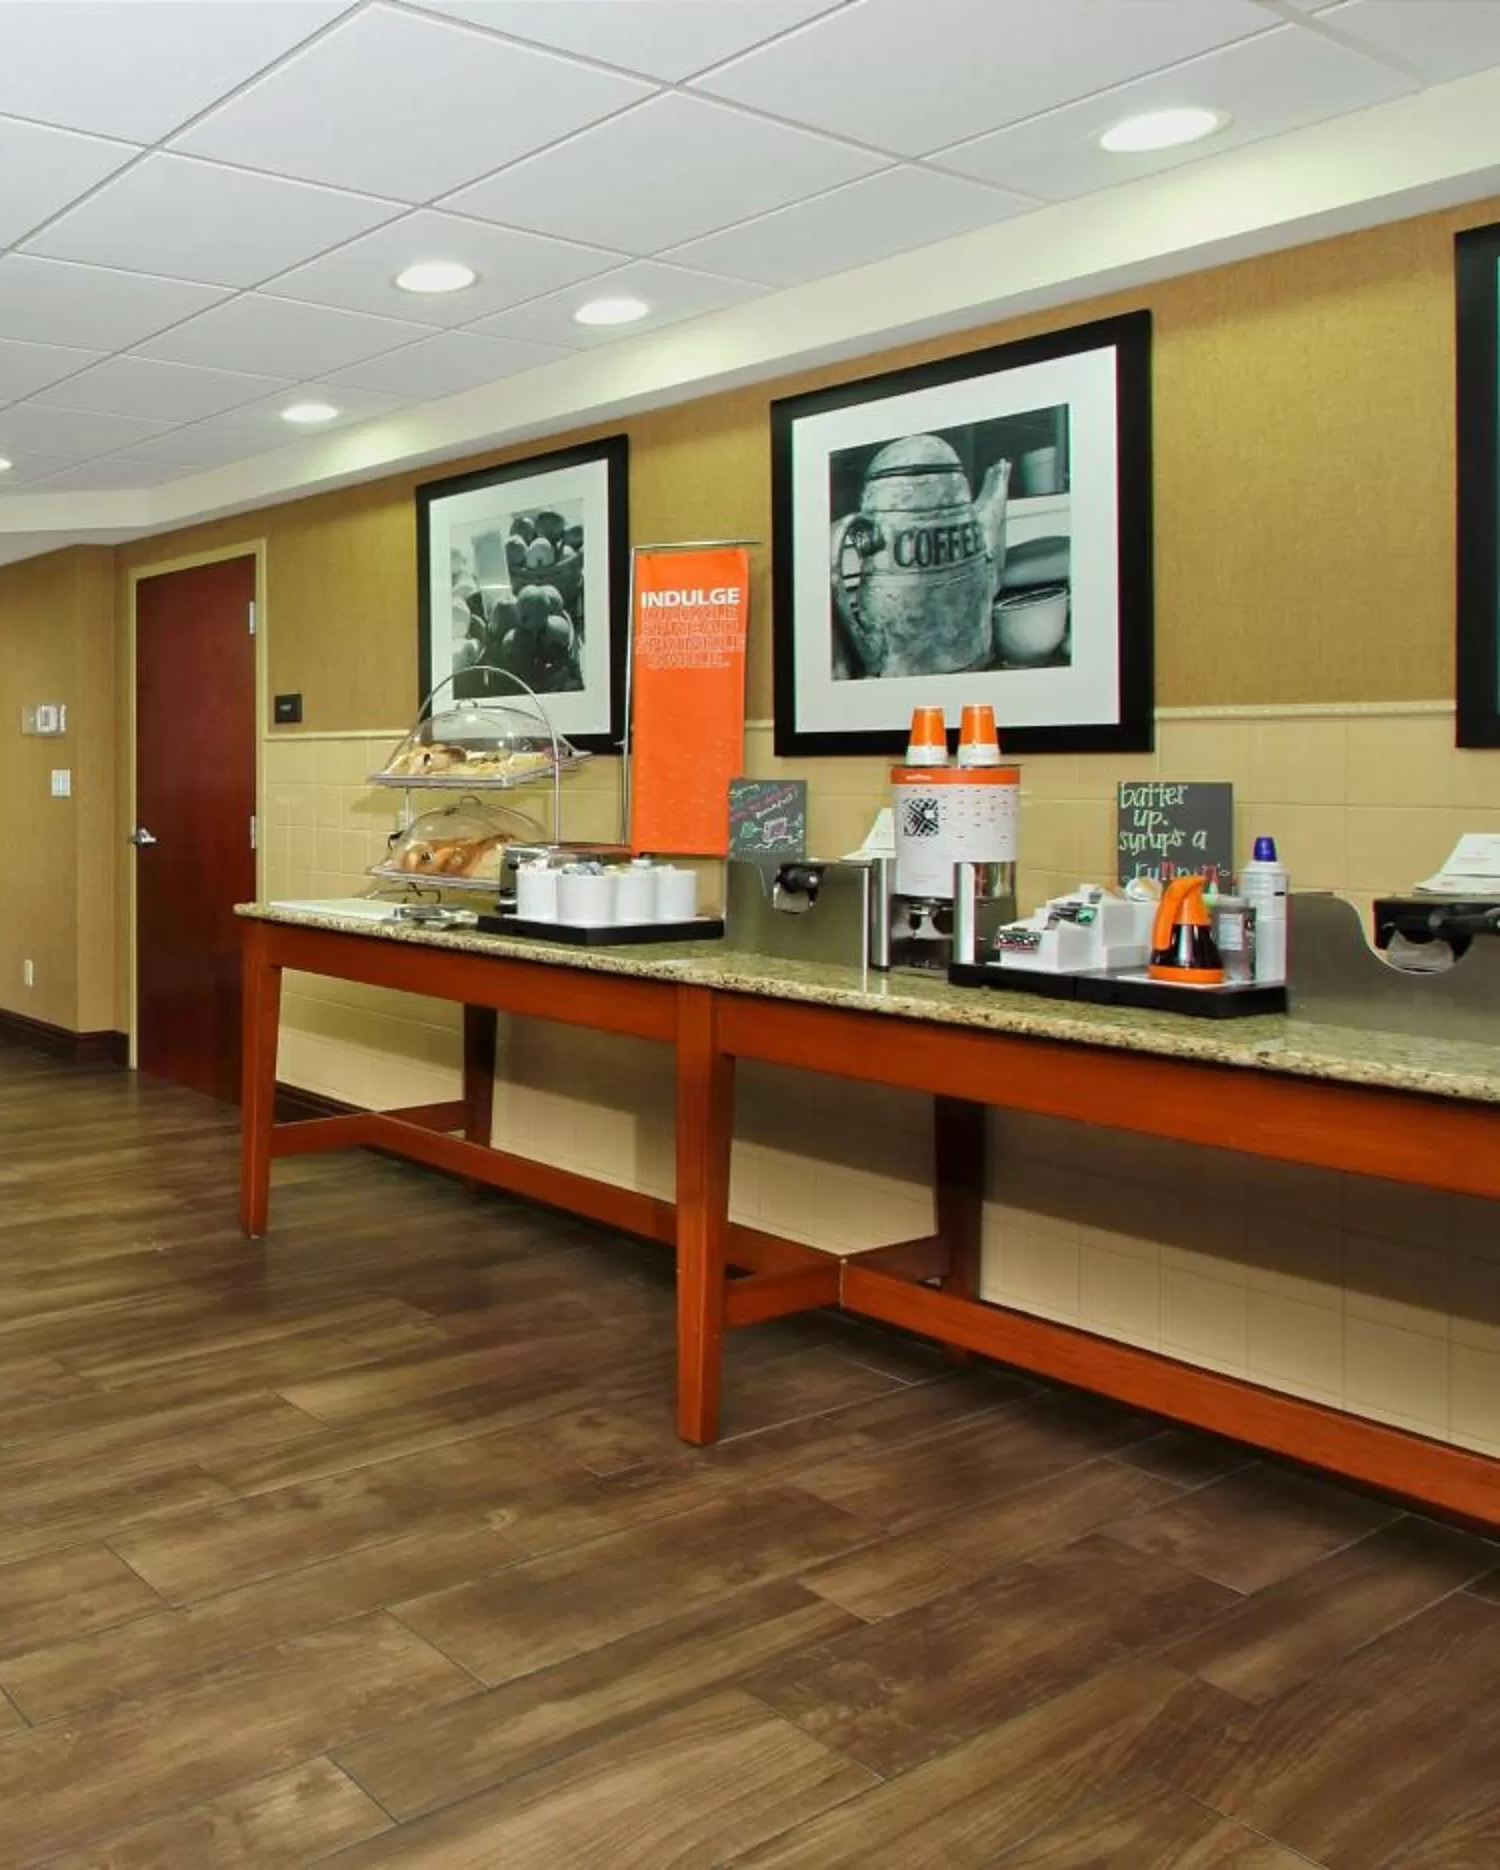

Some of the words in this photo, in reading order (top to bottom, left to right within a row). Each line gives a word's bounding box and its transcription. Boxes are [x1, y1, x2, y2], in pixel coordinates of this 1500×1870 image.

[894, 521, 986, 567] COFFEE
[641, 587, 741, 609] INDULGE
[1119, 780, 1188, 809] batter
[1133, 809, 1169, 835] up.
[1191, 830, 1208, 849] a
